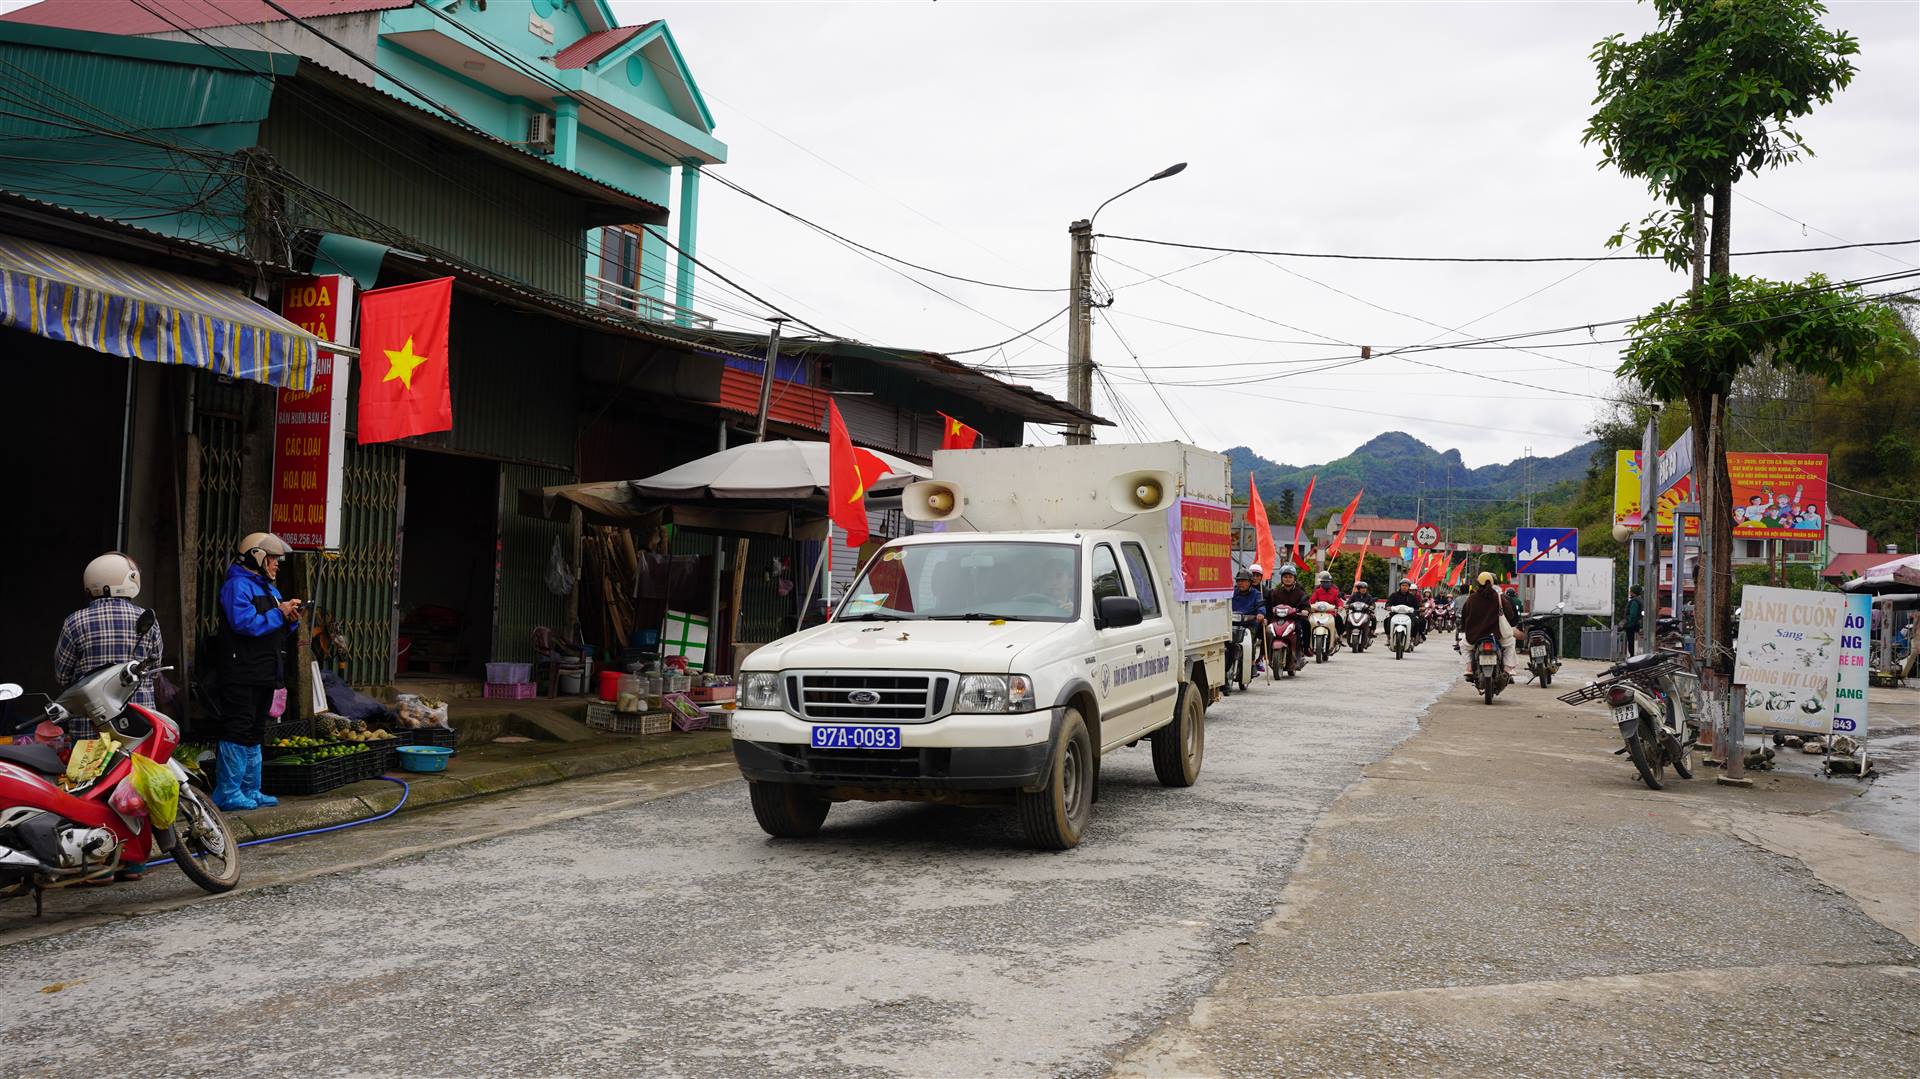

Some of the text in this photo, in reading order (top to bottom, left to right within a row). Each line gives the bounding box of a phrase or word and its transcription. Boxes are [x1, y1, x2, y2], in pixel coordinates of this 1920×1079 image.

[289, 286, 331, 307] HOA
[300, 313, 329, 341] UẢ
[316, 358, 332, 379] ẠNH
[285, 434, 321, 460] CÁC LOẠI
[283, 464, 317, 491] HOA QUẢ
[308, 497, 324, 525] QUẢ
[1743, 597, 1837, 628] BÁNH CUỐN
[1776, 628, 1804, 641] Sang
[1841, 635, 1862, 649] NG
[1851, 655, 1864, 667] EM
[1836, 688, 1863, 700] RANG
[816, 728, 896, 747] 97A-0093
